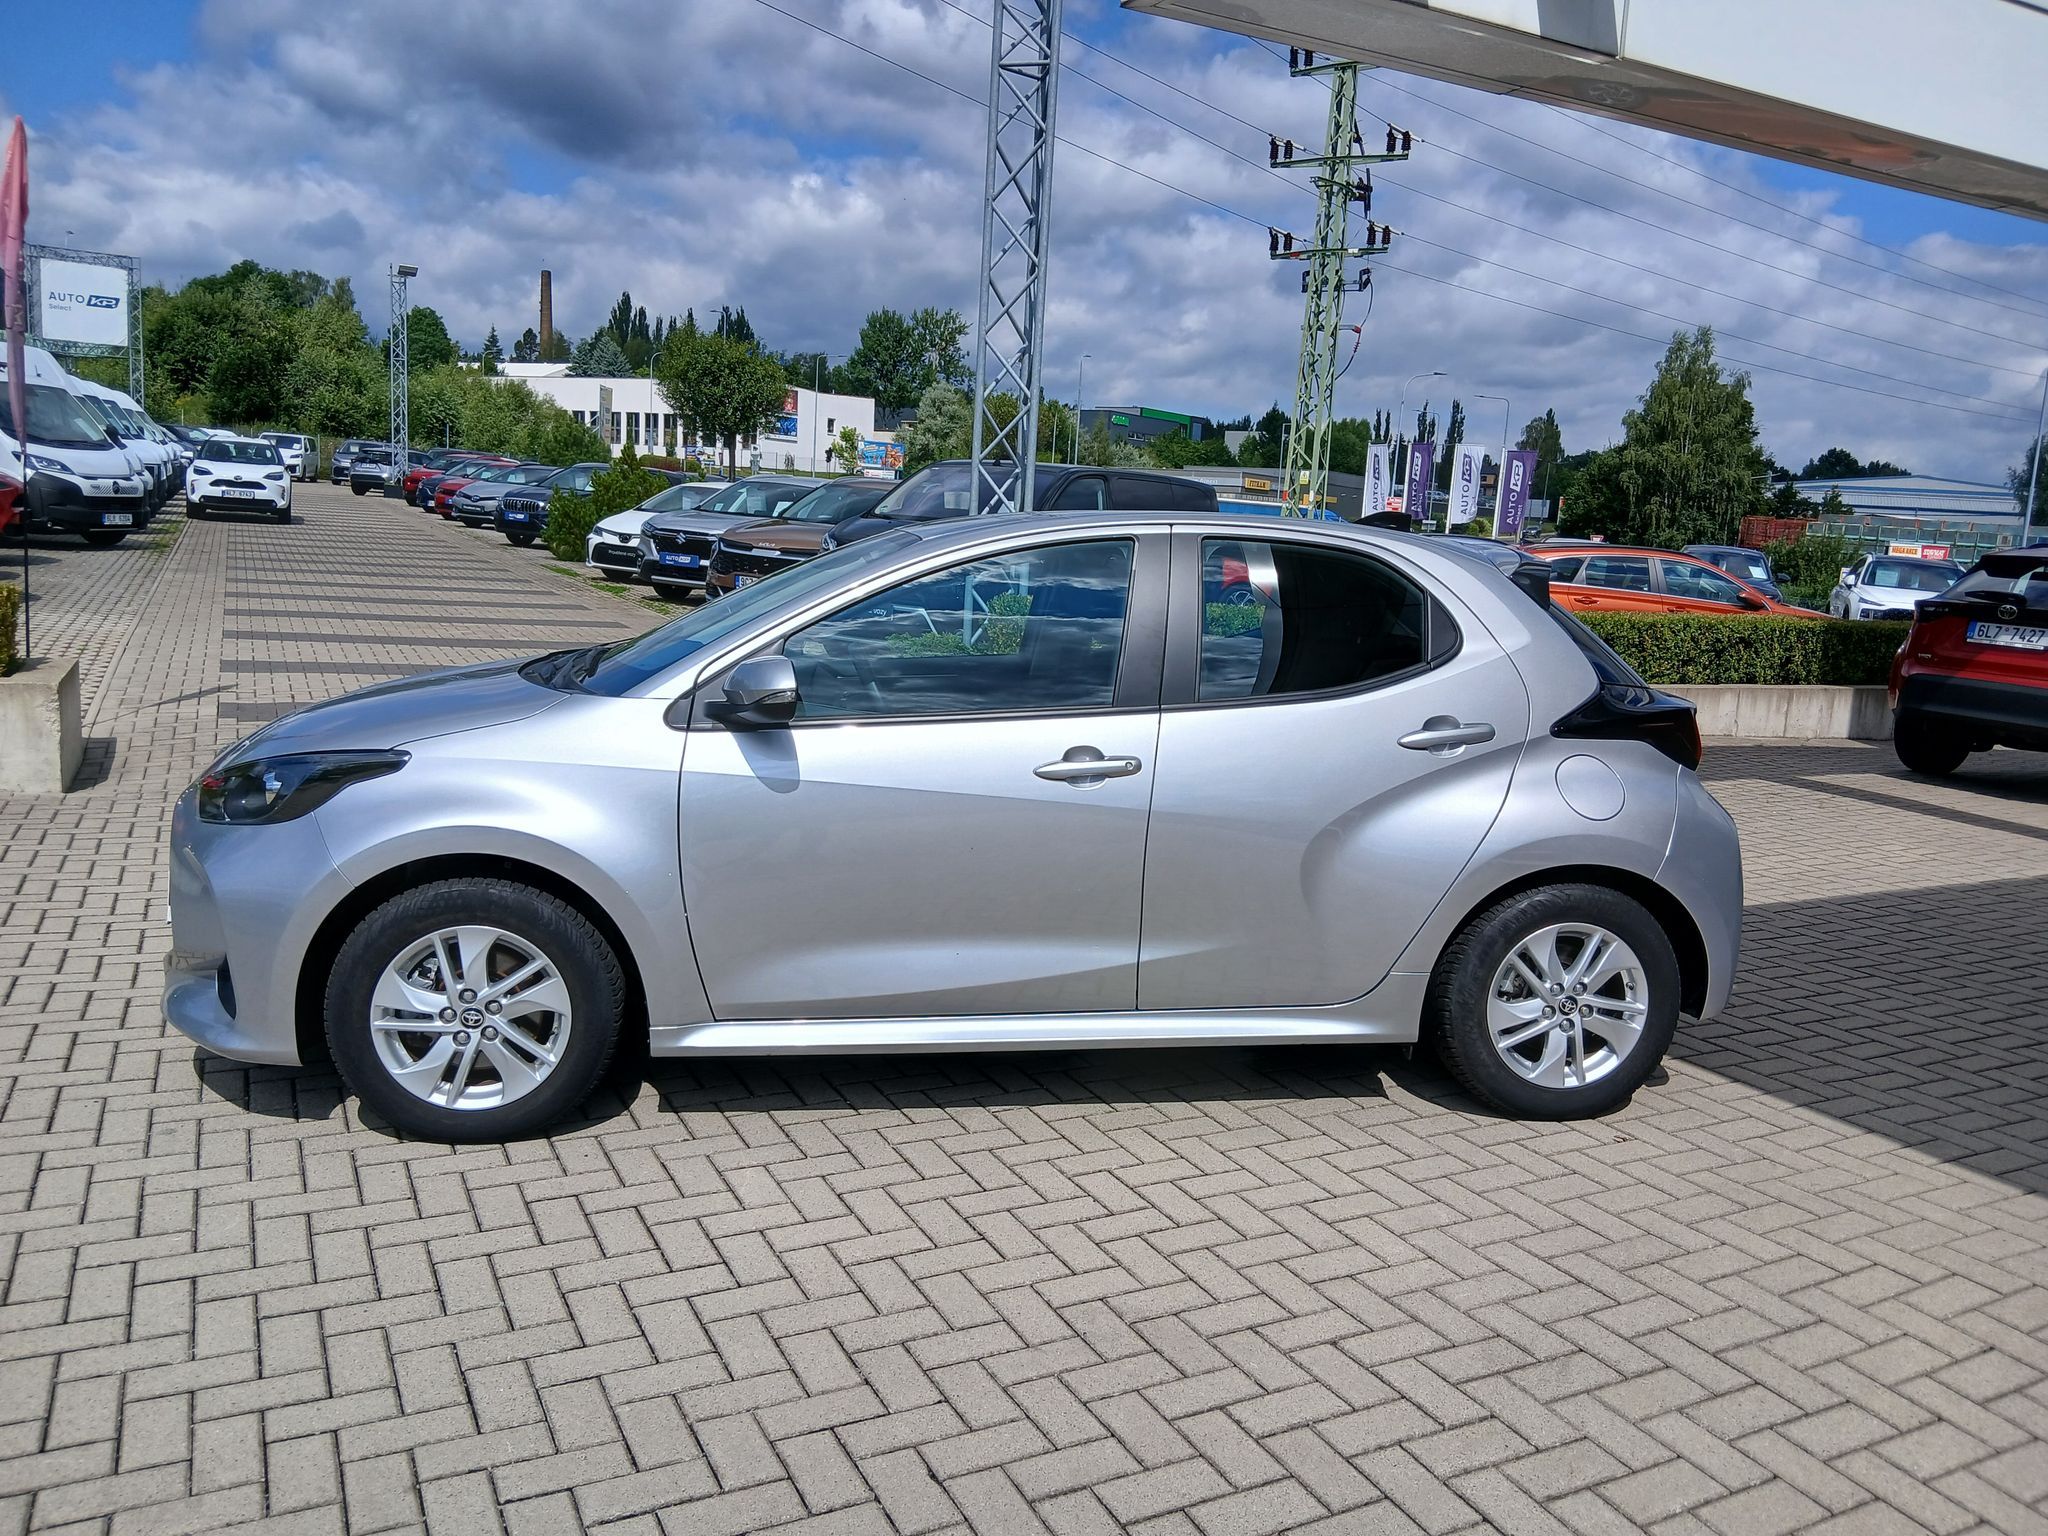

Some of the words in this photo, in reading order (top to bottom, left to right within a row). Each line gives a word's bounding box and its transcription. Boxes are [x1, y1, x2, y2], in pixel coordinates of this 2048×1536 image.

[49, 291, 85, 304] AUTO
[49, 303, 72, 312] Select
[1461, 484, 1470, 515] AUTO
[1506, 492, 1518, 525] AUTO
[873, 608, 887, 616] vozy
[1977, 624, 2002, 639] 6L7
[2010, 627, 2046, 643] 7427
